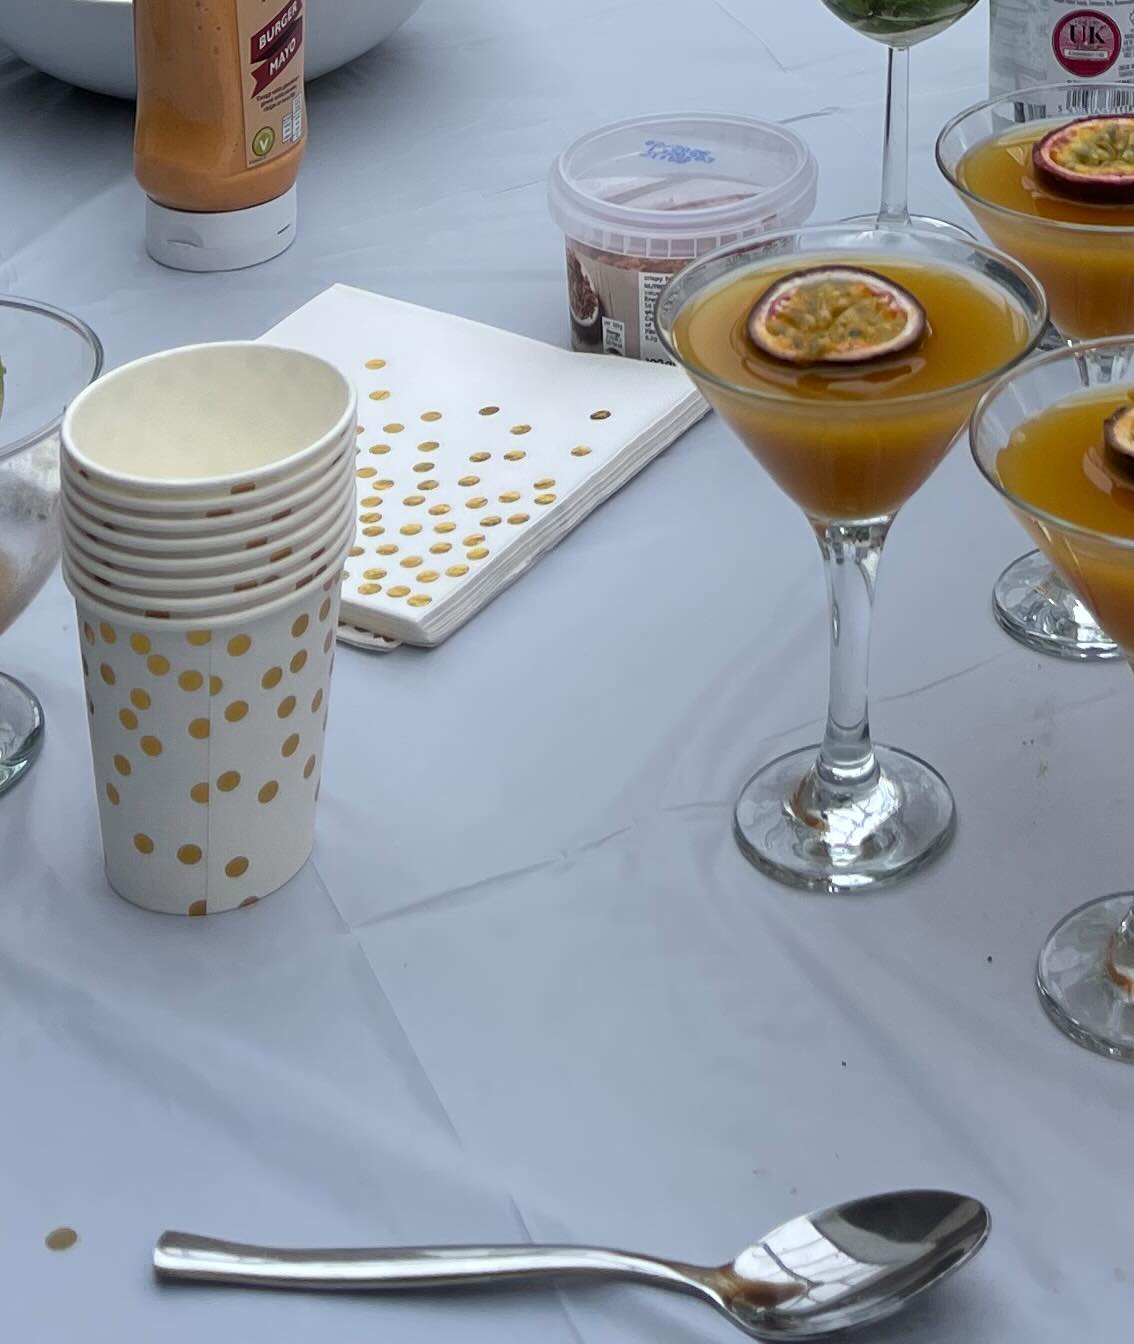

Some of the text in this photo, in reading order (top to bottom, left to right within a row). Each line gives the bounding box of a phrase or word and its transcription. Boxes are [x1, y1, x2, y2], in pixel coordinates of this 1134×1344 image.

[259, 0, 297, 50] BURGER
[1069, 24, 1106, 45] UK
[269, 37, 296, 76] MAYO
